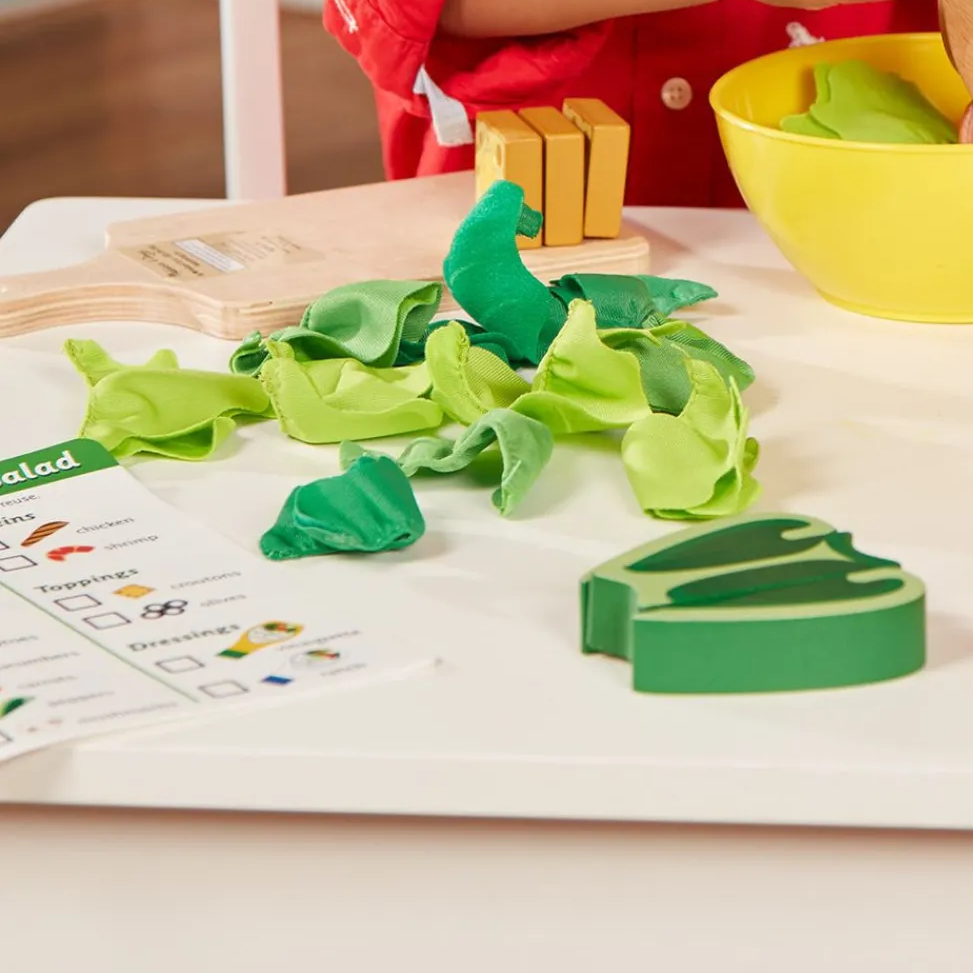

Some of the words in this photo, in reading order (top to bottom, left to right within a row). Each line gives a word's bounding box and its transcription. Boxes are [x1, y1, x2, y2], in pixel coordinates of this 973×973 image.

[0, 511, 36, 527] ins
[76, 516, 135, 534] chicken
[104, 534, 159, 551] shrimp
[35, 568, 139, 594] Toppings
[128, 623, 240, 653] Dressings
